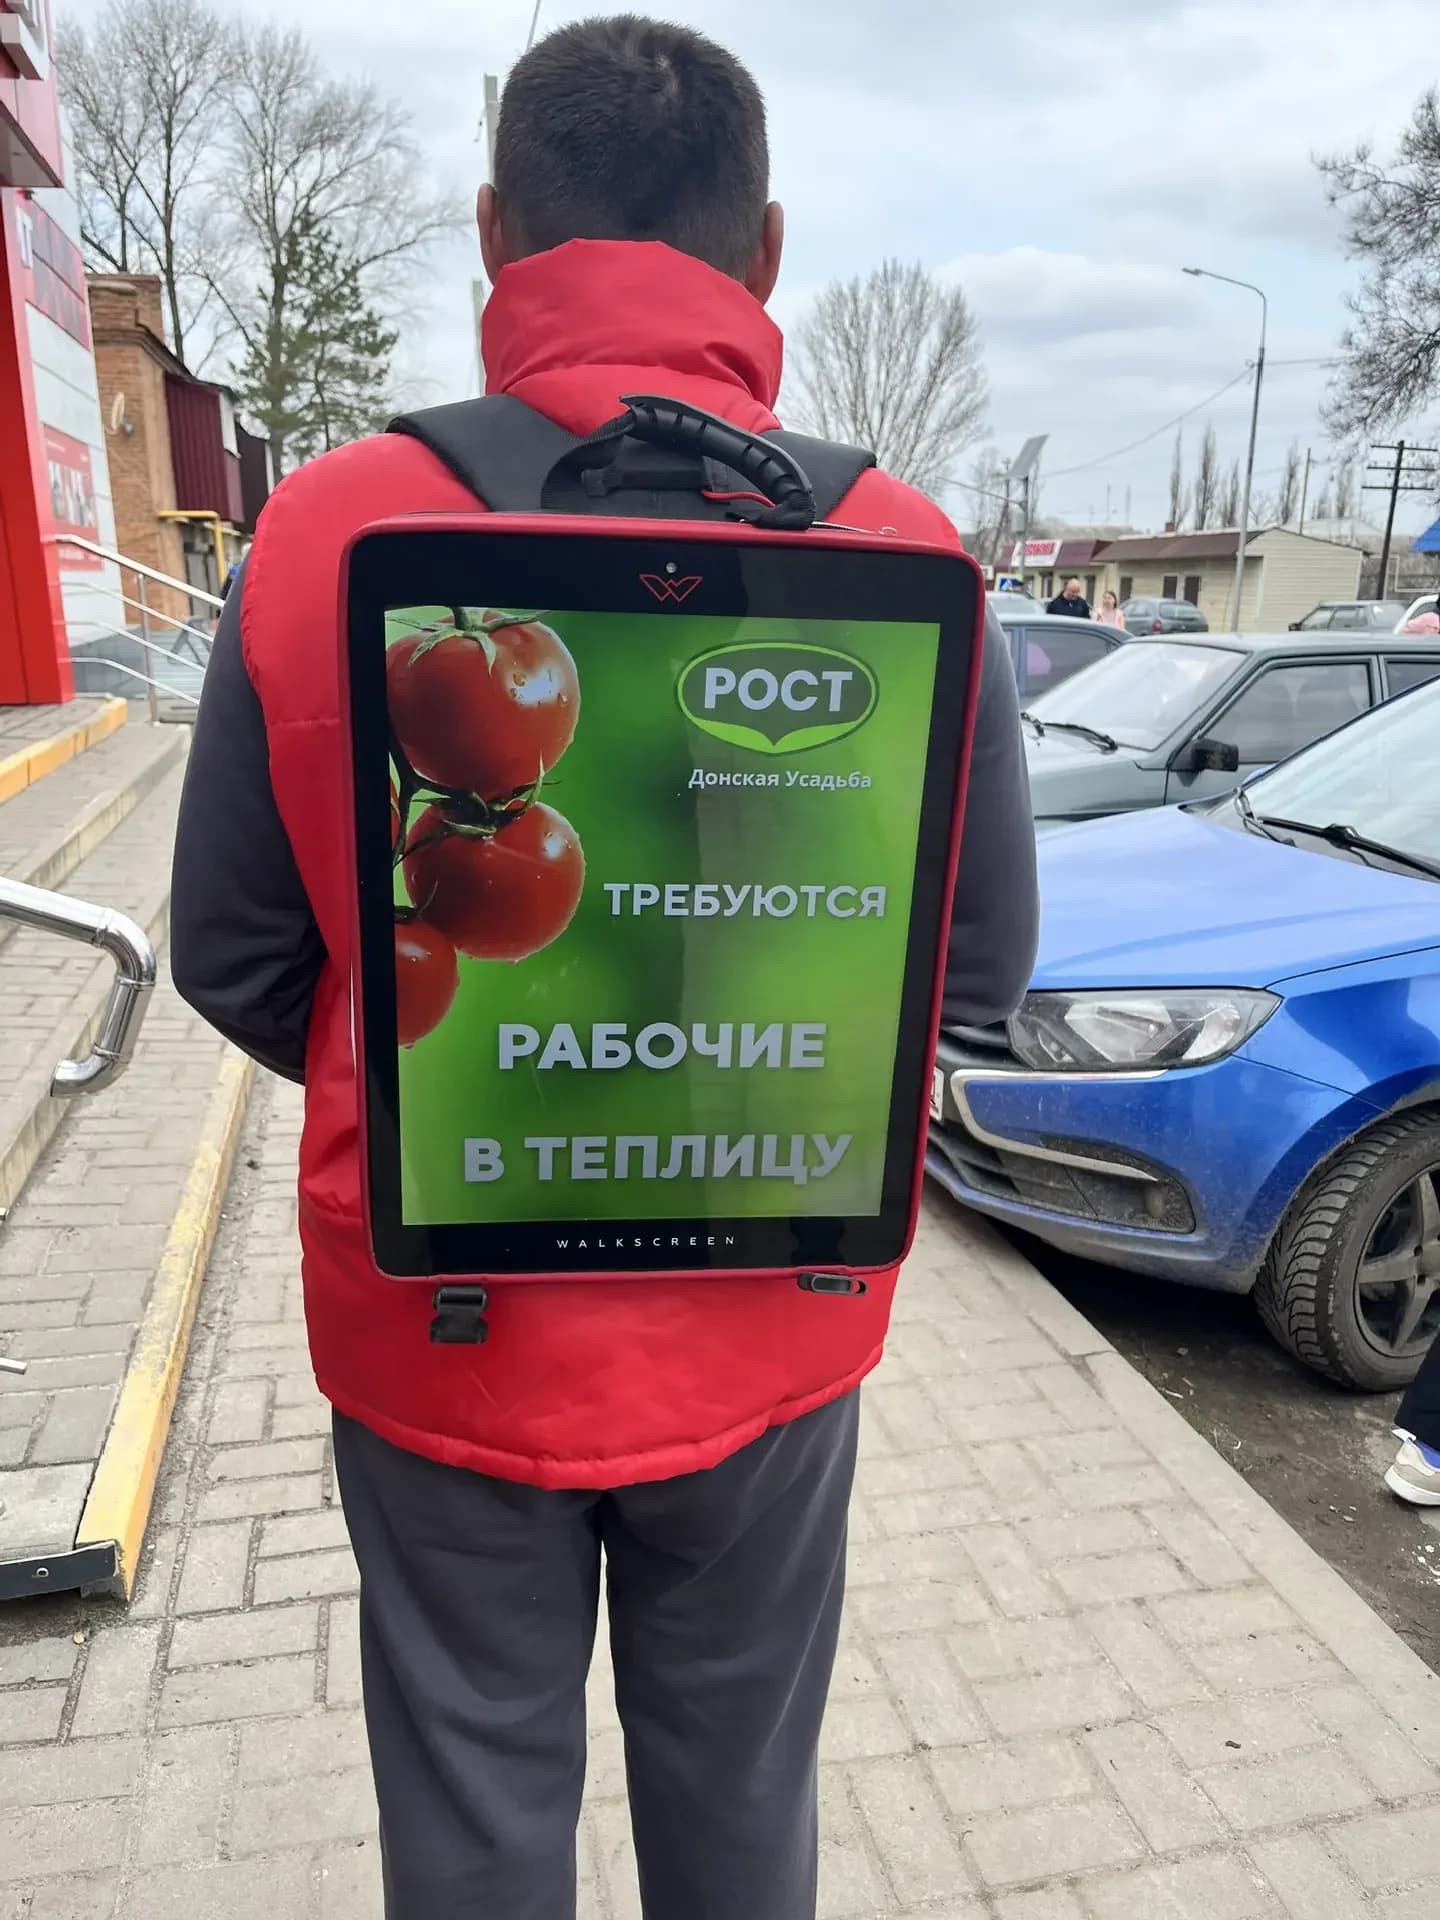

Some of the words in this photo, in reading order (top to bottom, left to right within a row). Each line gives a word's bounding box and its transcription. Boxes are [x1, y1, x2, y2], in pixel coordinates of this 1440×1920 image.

[704, 667, 853, 712] РОСТ
[688, 768, 780, 789] Донская
[785, 770, 872, 790] Усадьба
[604, 883, 886, 918] ТРЕБУЮТСЯ
[498, 1023, 826, 1070] РАБОЧИЕ
[464, 1138, 505, 1182] В
[525, 1134, 852, 1185] ТЕПЛИЦУ
[556, 1236, 735, 1249] WALKSCREEN
